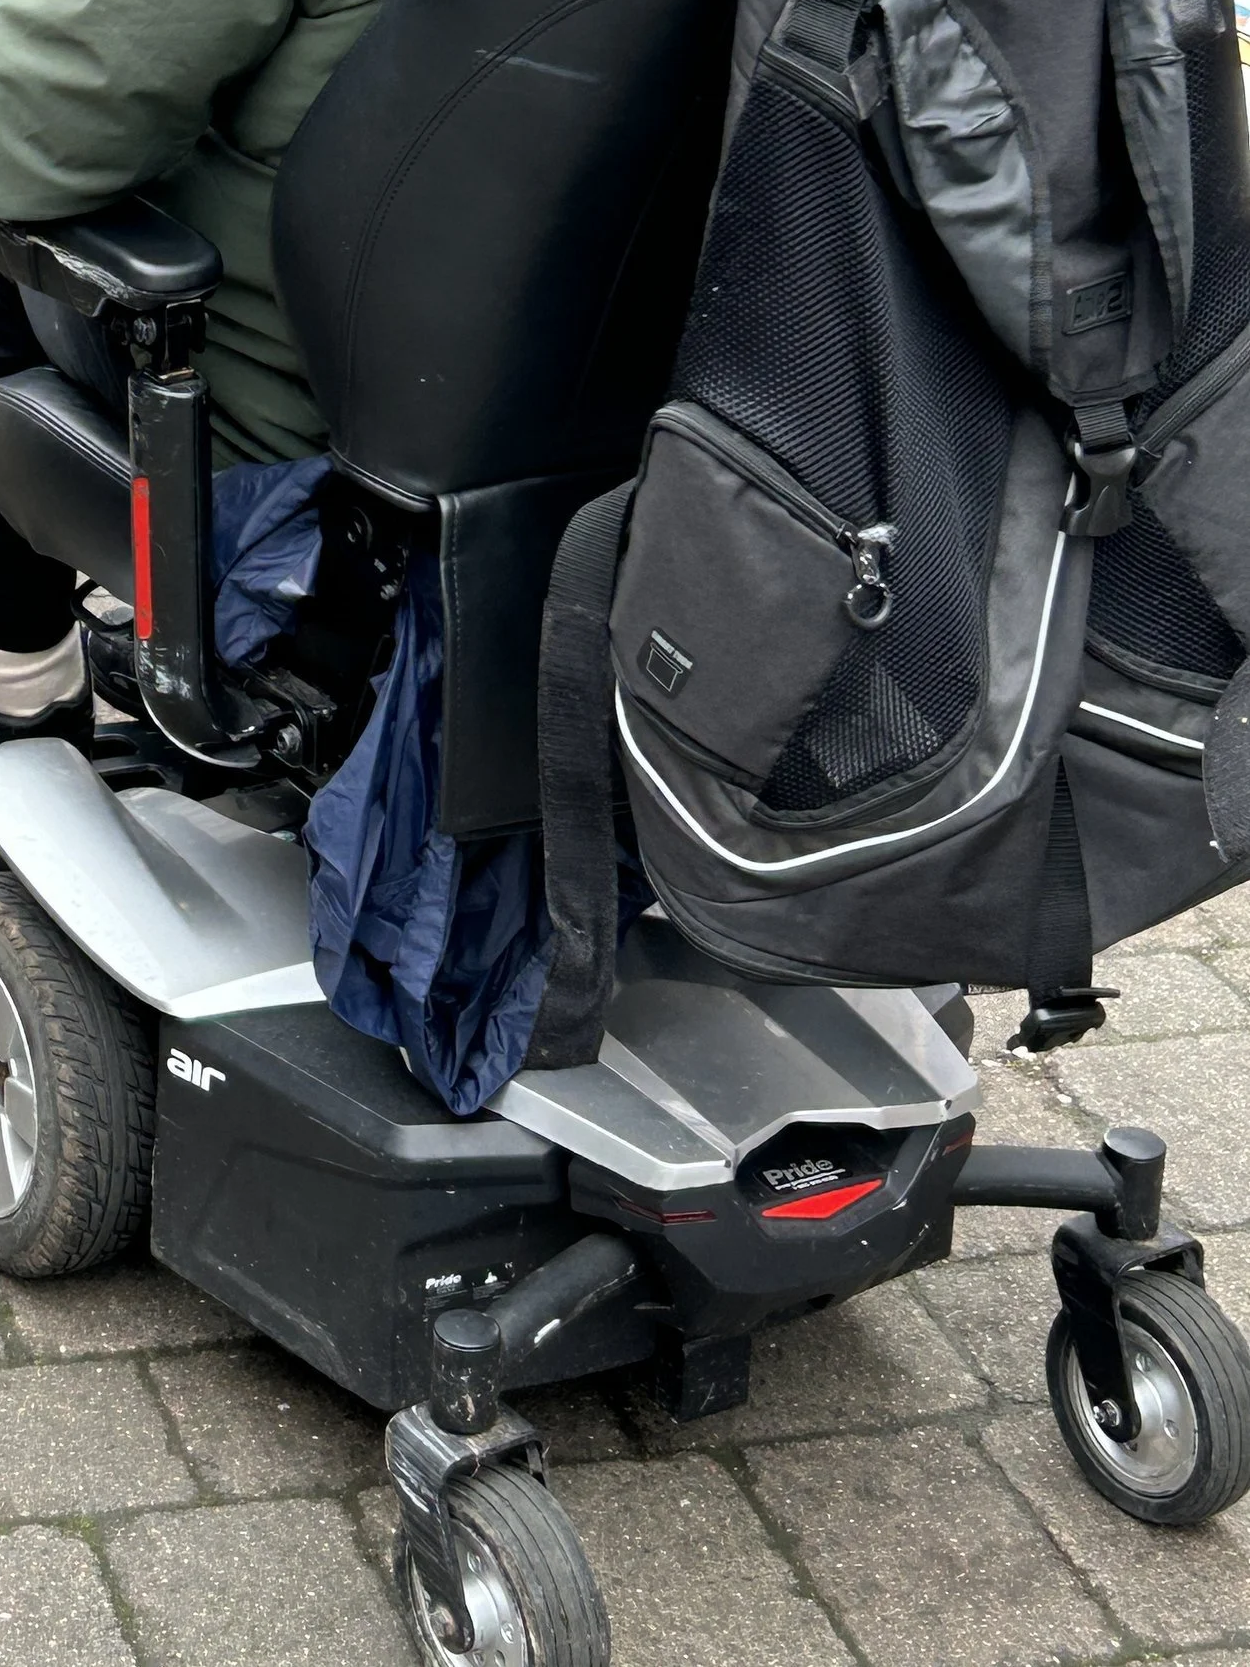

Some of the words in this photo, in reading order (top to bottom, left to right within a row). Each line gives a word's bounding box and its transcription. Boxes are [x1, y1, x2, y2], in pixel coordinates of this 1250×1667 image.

[166, 1047, 226, 1092] air
[762, 1159, 834, 1187] Pride
[425, 1274, 463, 1291] Pride
